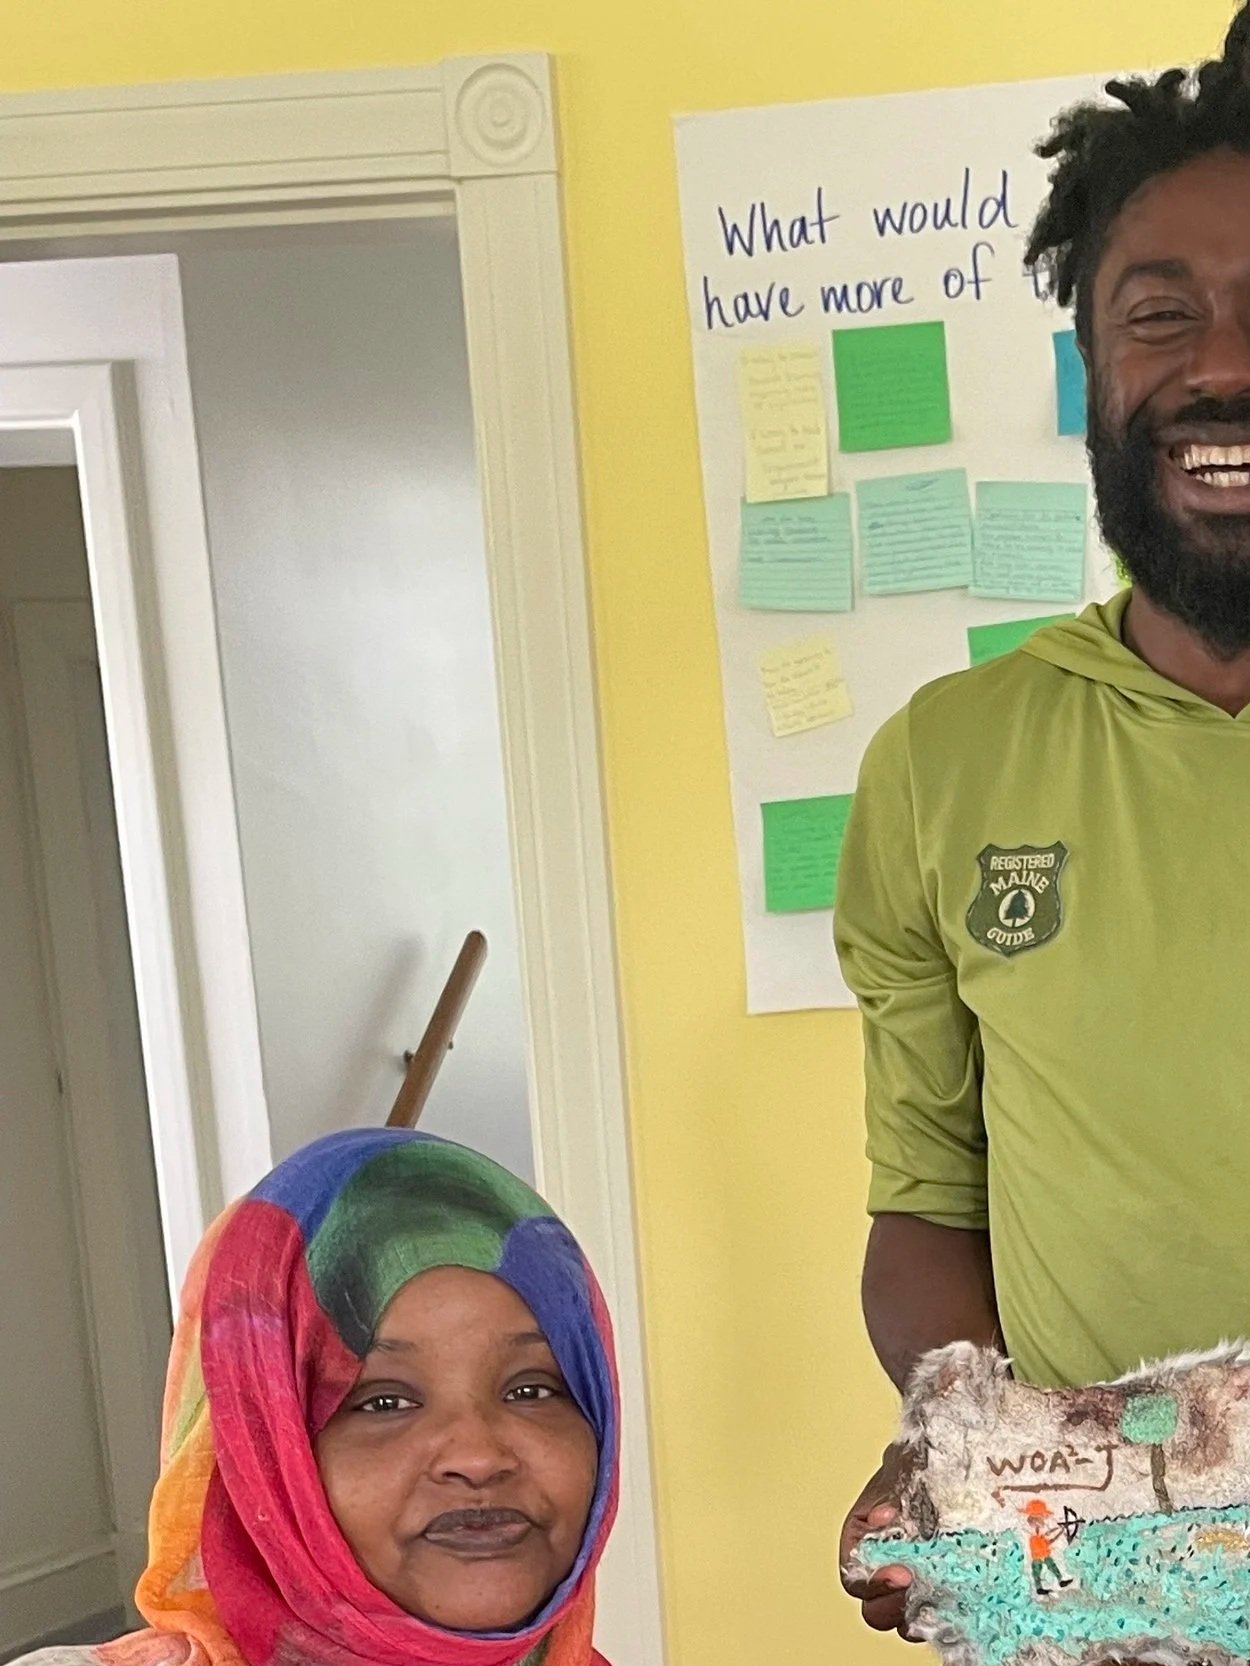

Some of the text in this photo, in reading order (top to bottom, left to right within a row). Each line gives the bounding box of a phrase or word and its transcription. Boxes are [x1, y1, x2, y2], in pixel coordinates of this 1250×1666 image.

[718, 167, 1018, 257] What would
[703, 276, 804, 330] have
[821, 276, 914, 313] more
[944, 242, 995, 300] of
[990, 853, 1055, 870] REGISTERED
[989, 870, 1050, 896] MAINE
[986, 927, 1035, 946] GUIDE
